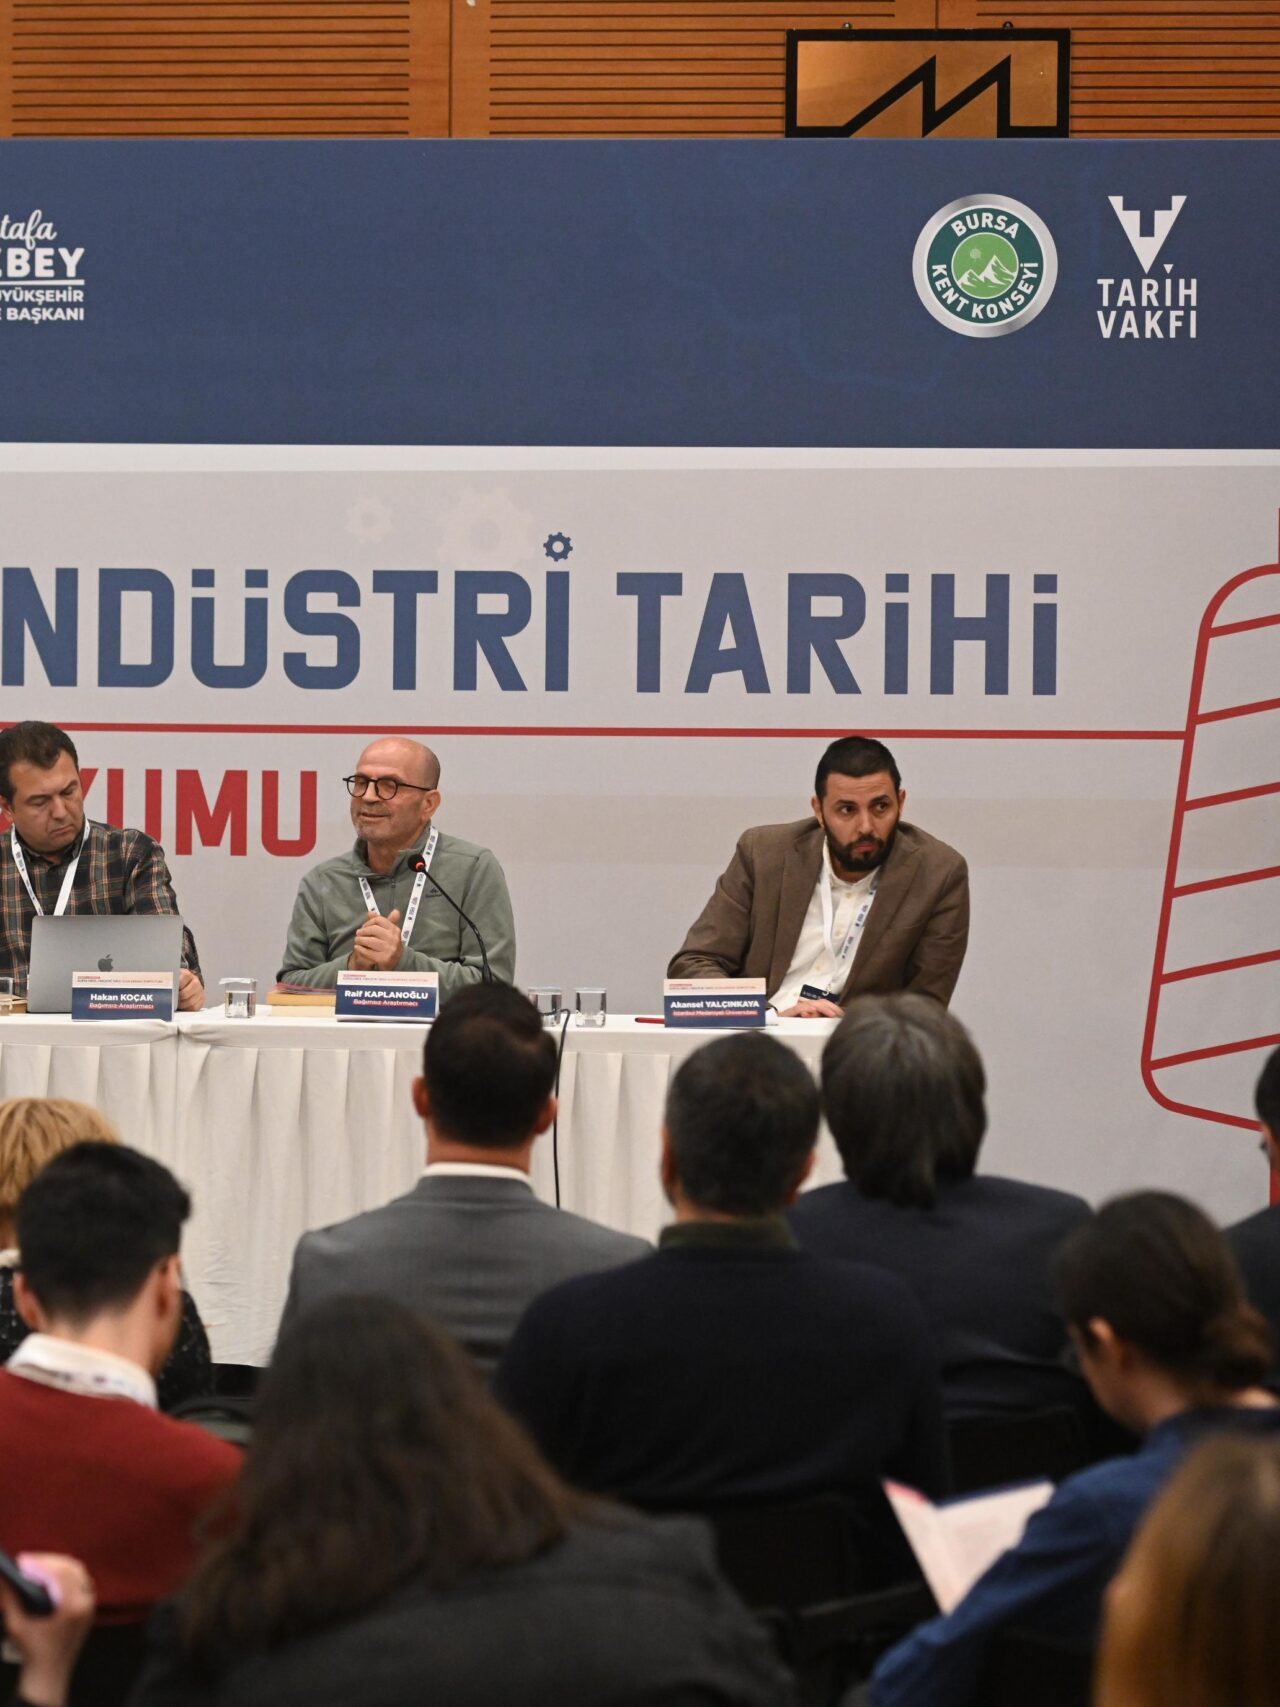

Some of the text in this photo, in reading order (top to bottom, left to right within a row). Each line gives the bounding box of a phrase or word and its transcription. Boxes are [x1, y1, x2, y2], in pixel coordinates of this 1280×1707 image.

[950, 212, 1021, 241] BURSA
[931, 261, 1040, 319] KENT KONSEYİ
[1096, 263, 1198, 307] TARİH
[6, 307, 84, 324] BAŞKANI
[1096, 310, 1198, 339] VAKFI
[616, 571, 1058, 696] TARİHİ
[90, 993, 154, 1003] Hakan KOÇAK
[344, 990, 429, 1000] Raif KAPLANOĞLU
[670, 1000, 760, 1009] Akansel YALÇINKAYA
